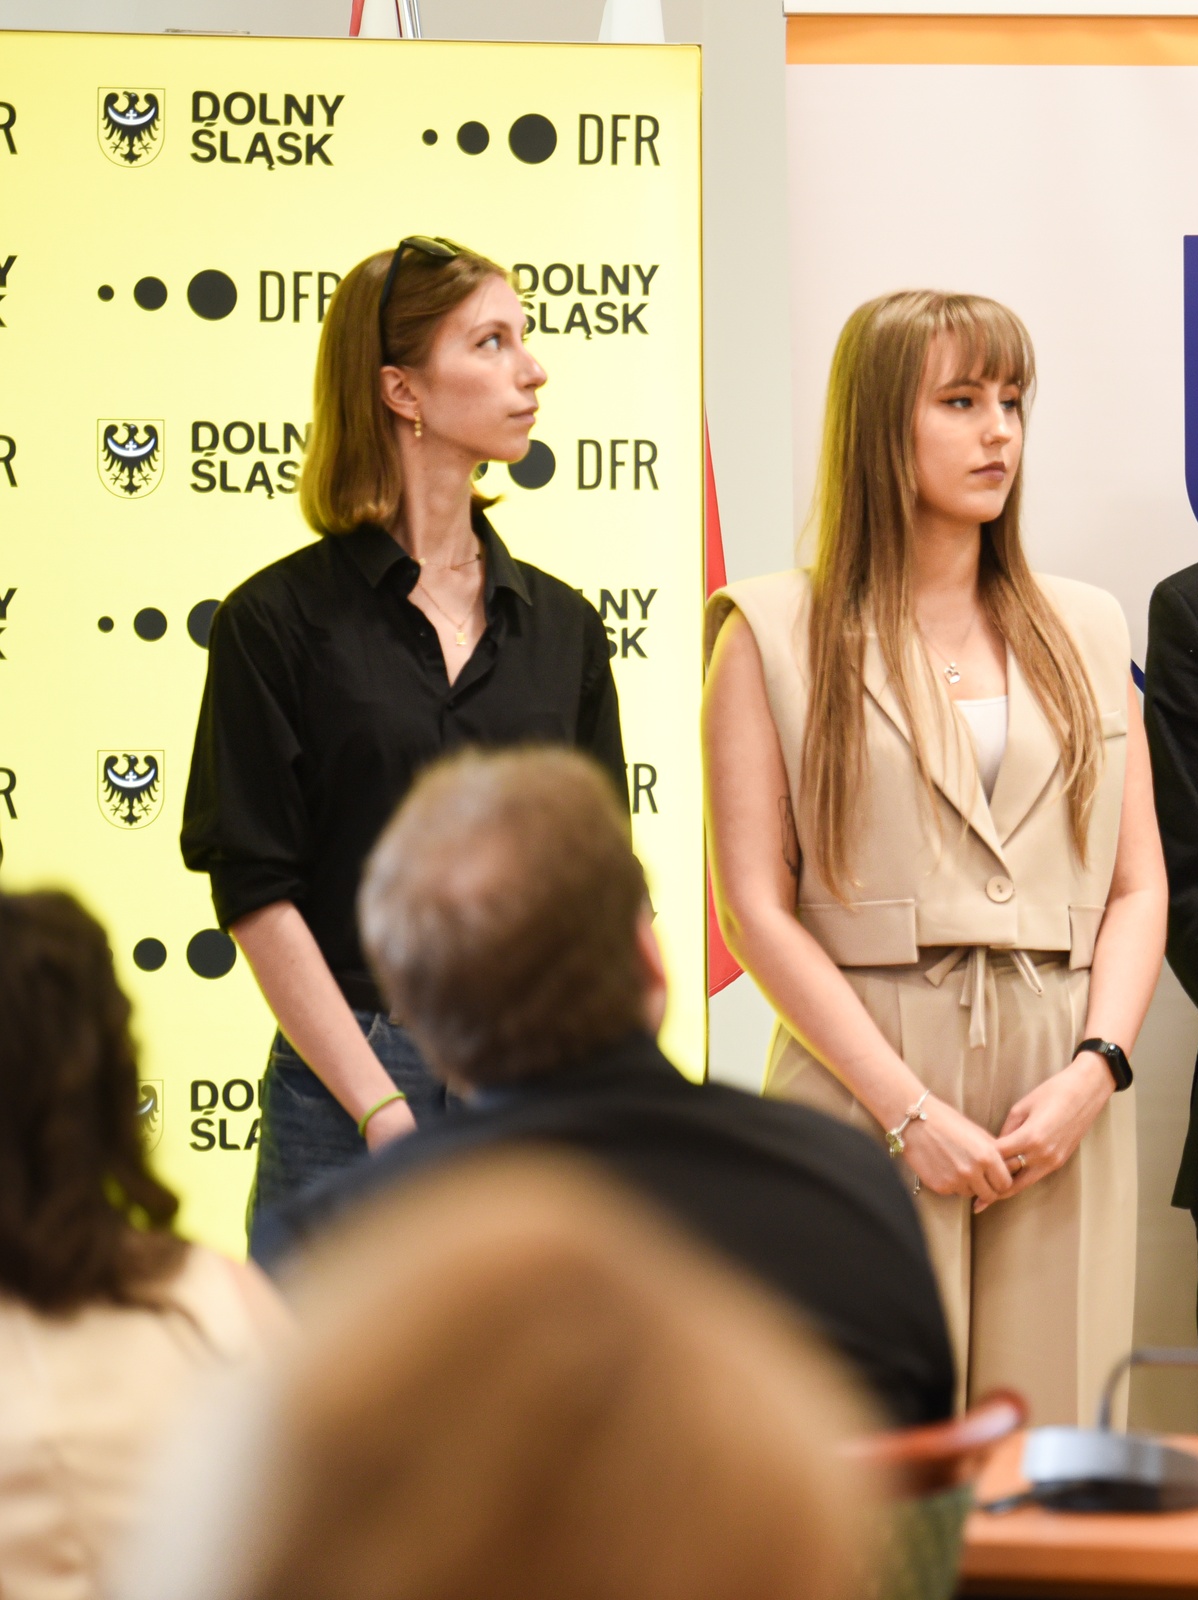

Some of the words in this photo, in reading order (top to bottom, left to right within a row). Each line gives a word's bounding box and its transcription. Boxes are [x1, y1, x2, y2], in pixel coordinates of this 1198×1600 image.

[191, 90, 346, 127] DOLNY
[190, 122, 334, 171] ŚLĄSK
[578, 113, 660, 166] DFR
[511, 263, 660, 296] DOLNY
[191, 420, 314, 455] DOLN
[190, 451, 302, 500] ŚLĄS
[578, 439, 659, 490] DFR
